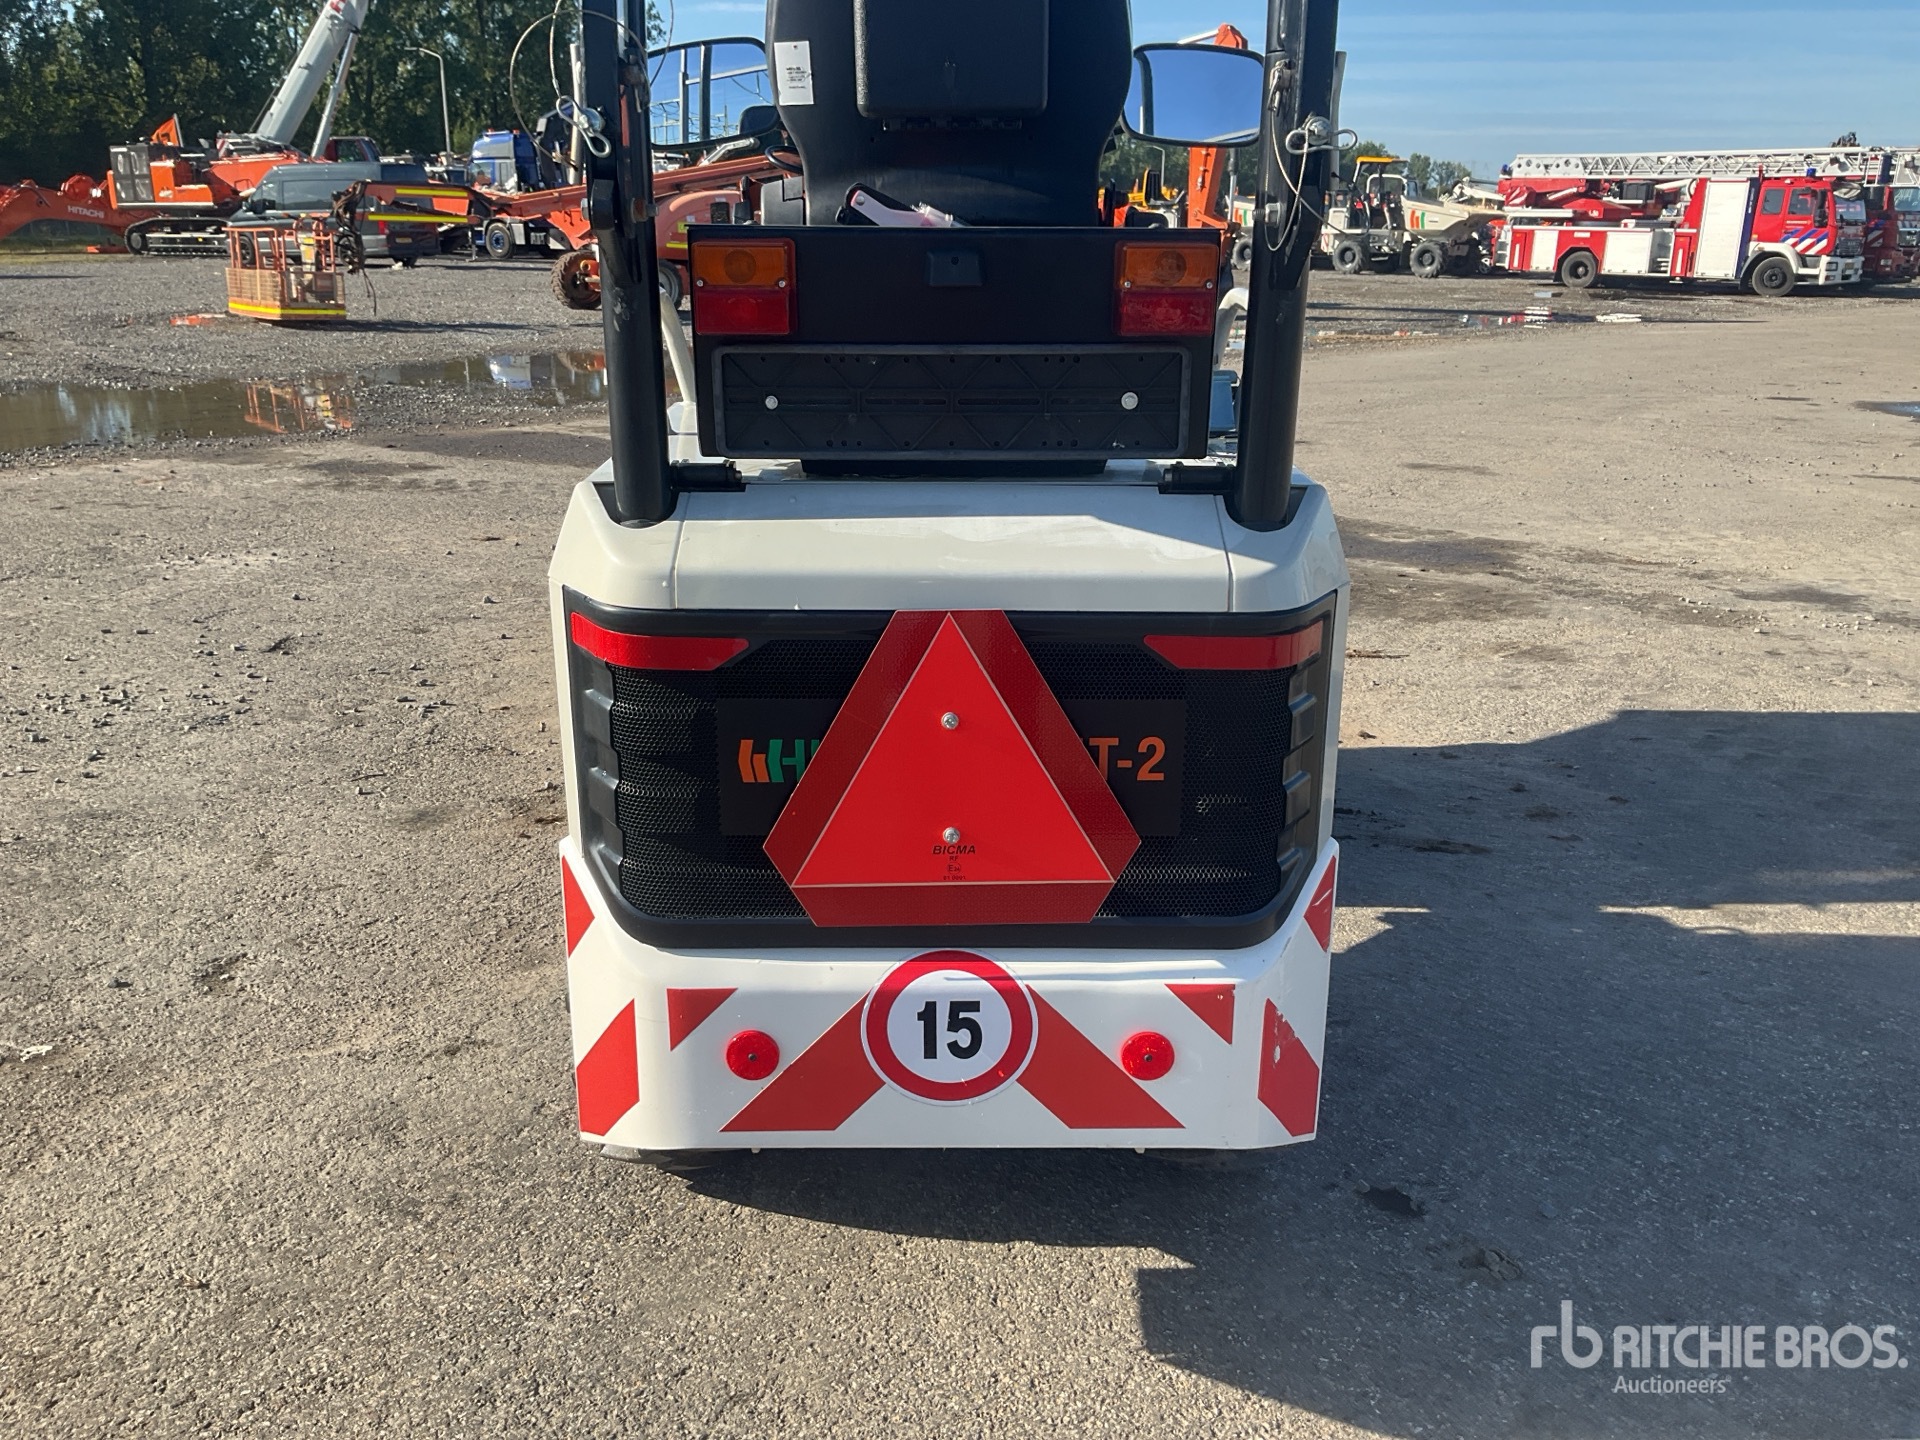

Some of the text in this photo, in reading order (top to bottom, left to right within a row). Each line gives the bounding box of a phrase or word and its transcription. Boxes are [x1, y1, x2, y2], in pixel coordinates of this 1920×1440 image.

[67, 205, 105, 219] HITACHI
[1080, 736, 1165, 781] T-2
[932, 845, 976, 855] BICMA
[916, 1000, 983, 1060] 15
